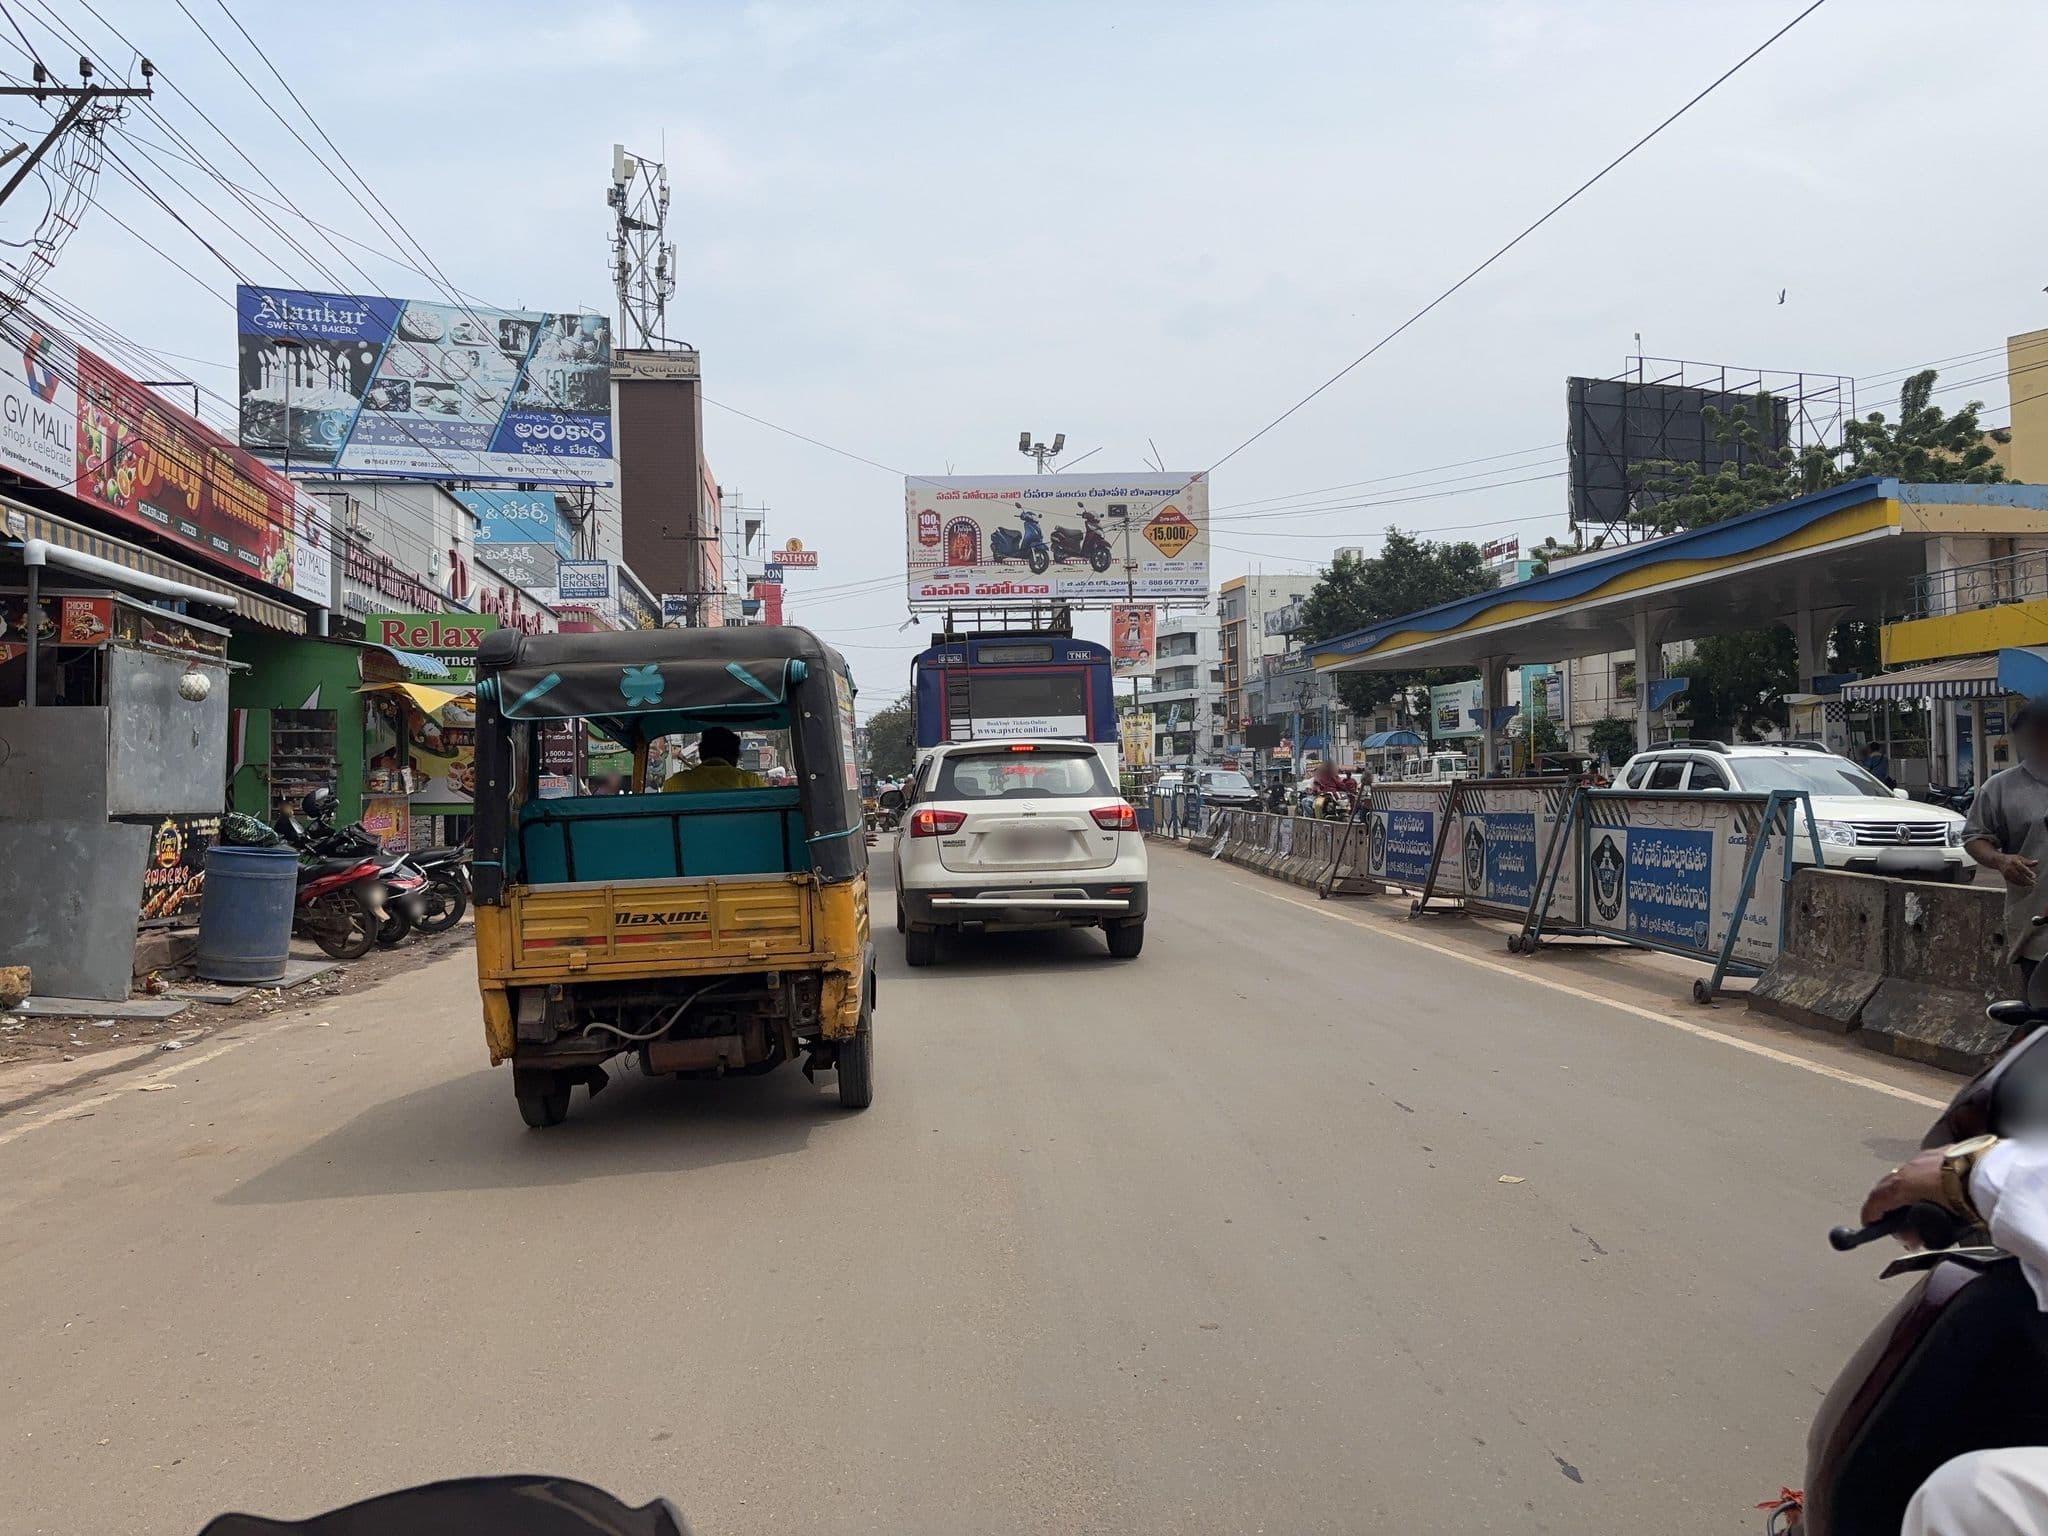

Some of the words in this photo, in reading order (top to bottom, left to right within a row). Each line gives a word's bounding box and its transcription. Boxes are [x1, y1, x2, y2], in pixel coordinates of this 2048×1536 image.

[253, 294, 368, 326] Alankar
[266, 320, 309, 332] SWEETS
[311, 323, 319, 333] &
[321, 324, 359, 335] BAKERS
[3, 393, 29, 429] GV
[33, 406, 72, 452] MALL
[514, 422, 606, 443] అలంకార్
[2, 424, 26, 447] shop
[26, 437, 32, 448] &
[33, 439, 72, 468] celebrate
[553, 445, 564, 454] &
[936, 490, 960, 501] పవన్
[1023, 488, 1054, 499] దసరా
[485, 507, 499, 520] &
[774, 553, 816, 563] SATHYA
[562, 573, 605, 581] SPOKEN
[562, 580, 606, 588] ENGLISH
[921, 582, 970, 596] పవన్
[975, 580, 1049, 595] హోండా
[66, 601, 94, 610] CHICKEN
[379, 618, 485, 649] Relax
[977, 725, 1058, 735] www.apsrtconline.in
[1635, 800, 1729, 828] STOP
[1645, 841, 1661, 871] ఫోన్
[144, 865, 190, 888] SNACKS
